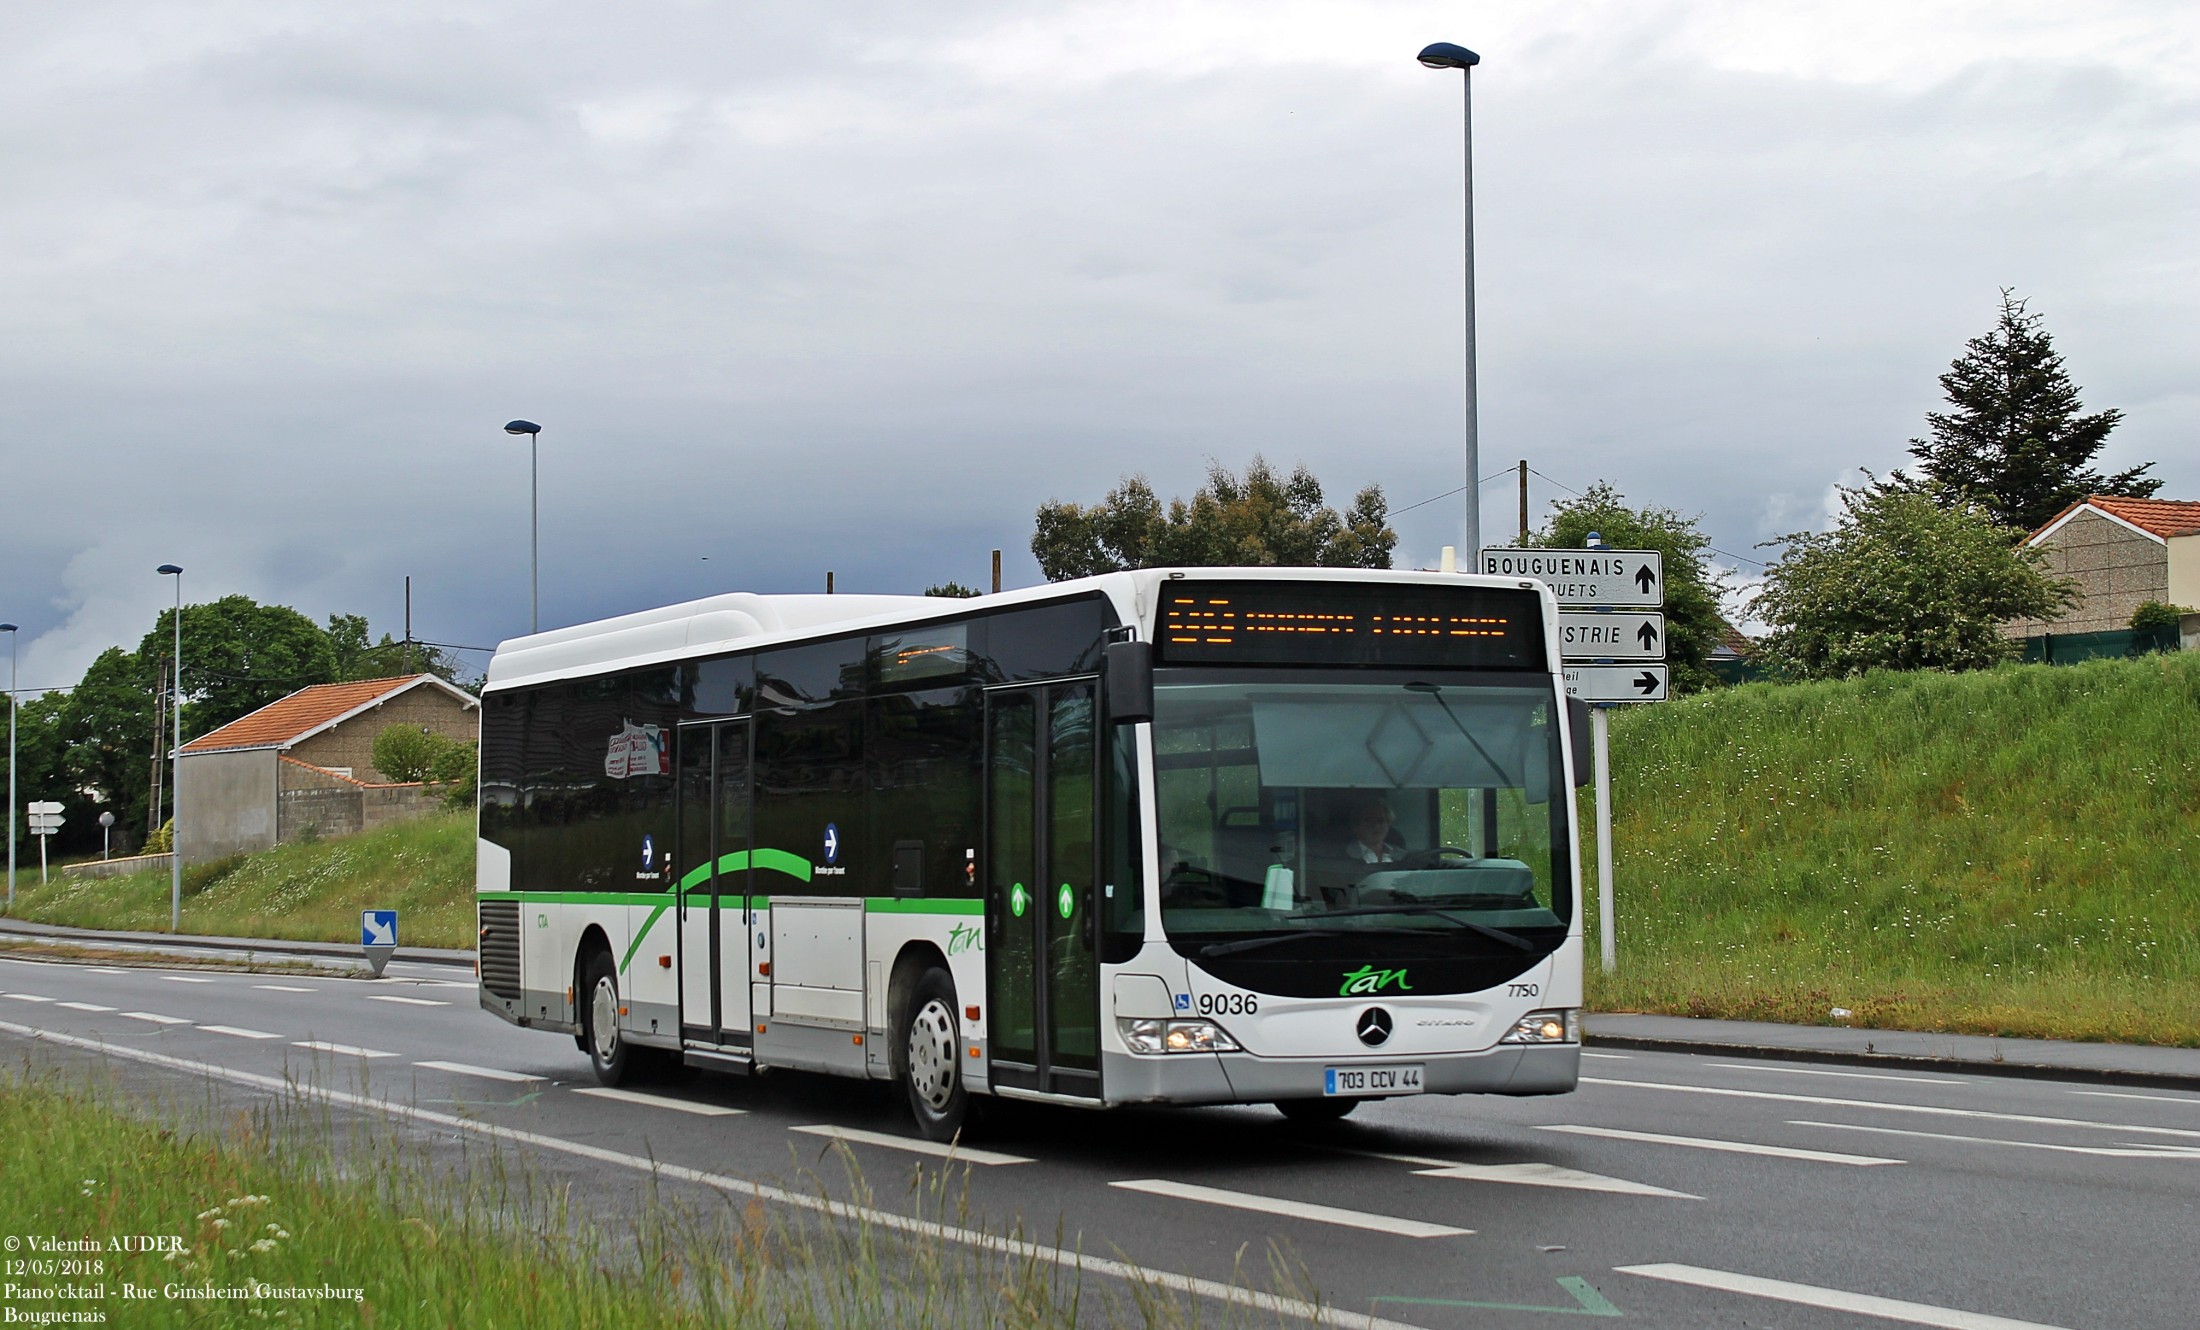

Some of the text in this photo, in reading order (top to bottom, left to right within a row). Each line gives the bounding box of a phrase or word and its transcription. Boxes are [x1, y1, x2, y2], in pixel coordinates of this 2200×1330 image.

[1487, 557, 1624, 576] BOUGUENAIS
[1559, 626, 1620, 643] STRIE
[948, 921, 984, 957] tan
[1339, 964, 1414, 997] tan
[1507, 983, 1539, 998] 7750
[1200, 993, 1258, 1015] 9036
[1338, 1069, 1419, 1089] 703 CCV 44
